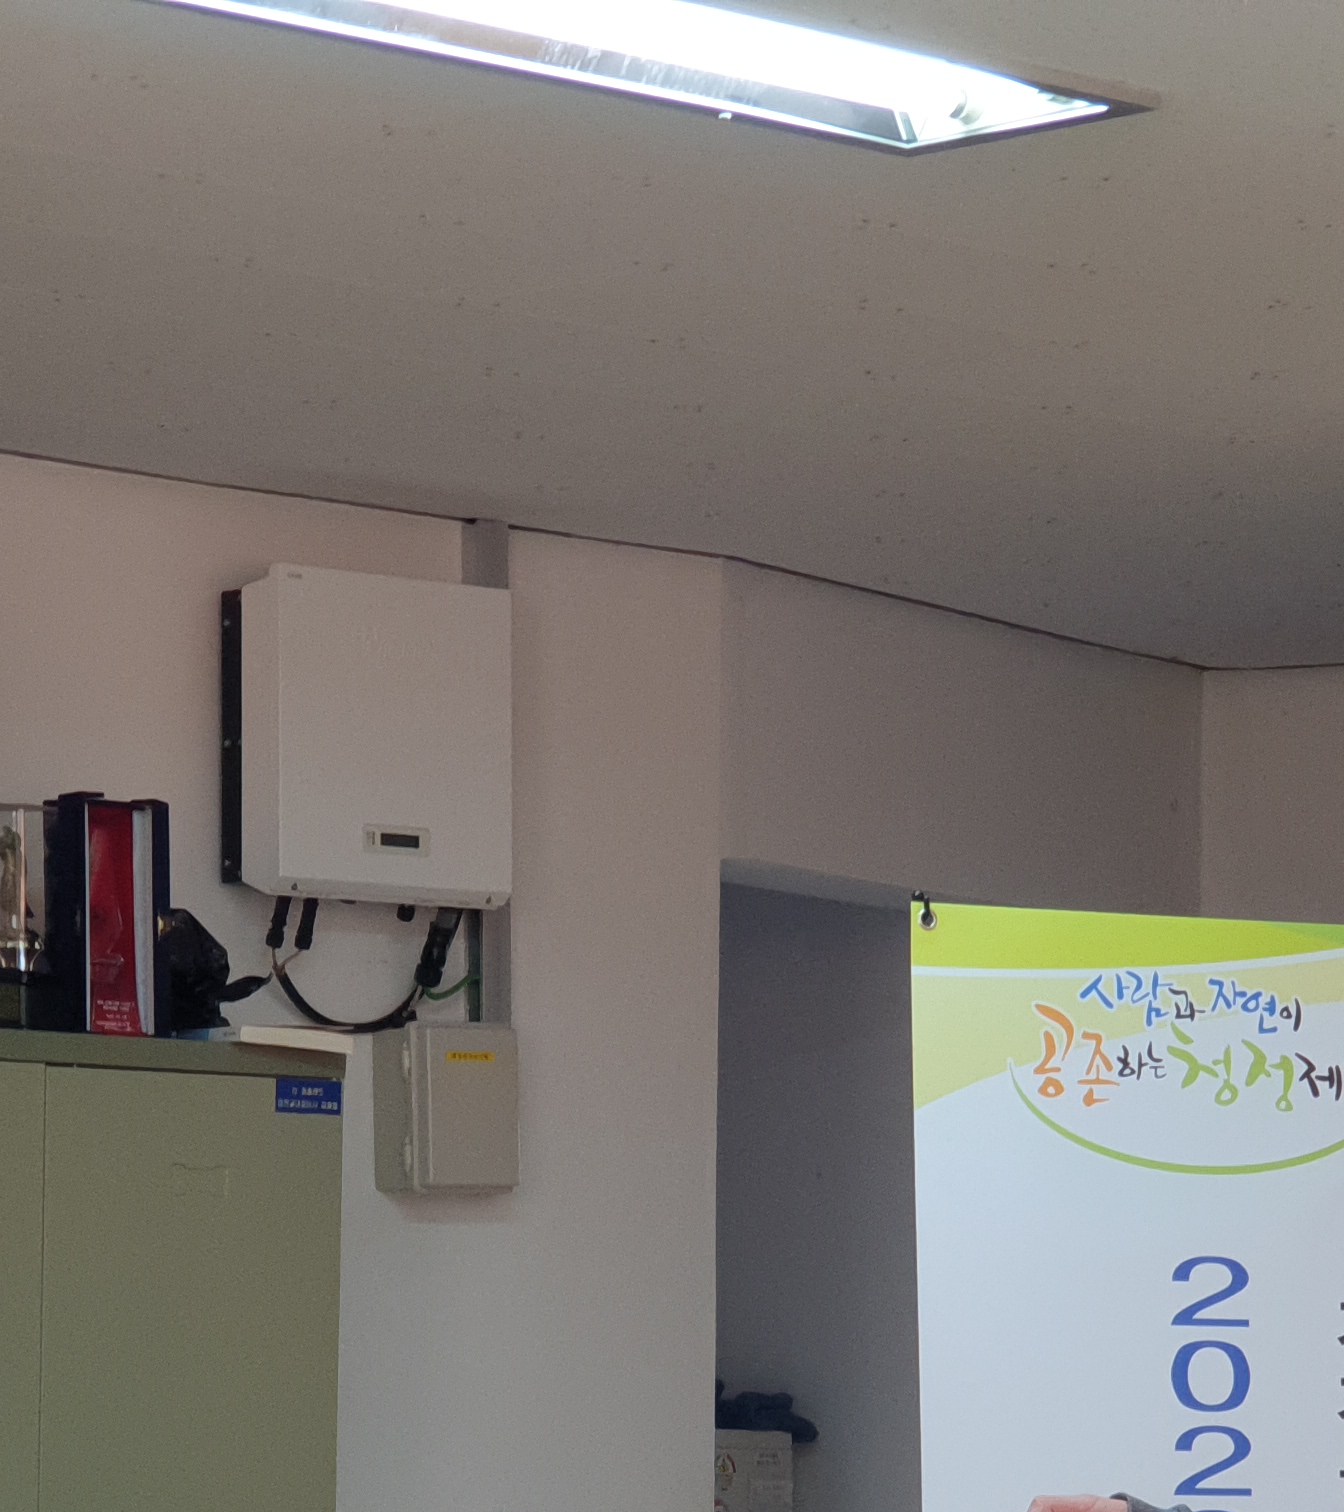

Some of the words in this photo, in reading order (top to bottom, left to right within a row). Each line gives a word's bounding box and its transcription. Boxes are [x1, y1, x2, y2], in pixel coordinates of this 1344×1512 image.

[1080, 970, 1206, 1027] 사람과
[1206, 977, 1302, 1034] 자연이
[1032, 1002, 1168, 1107] 공존하는
